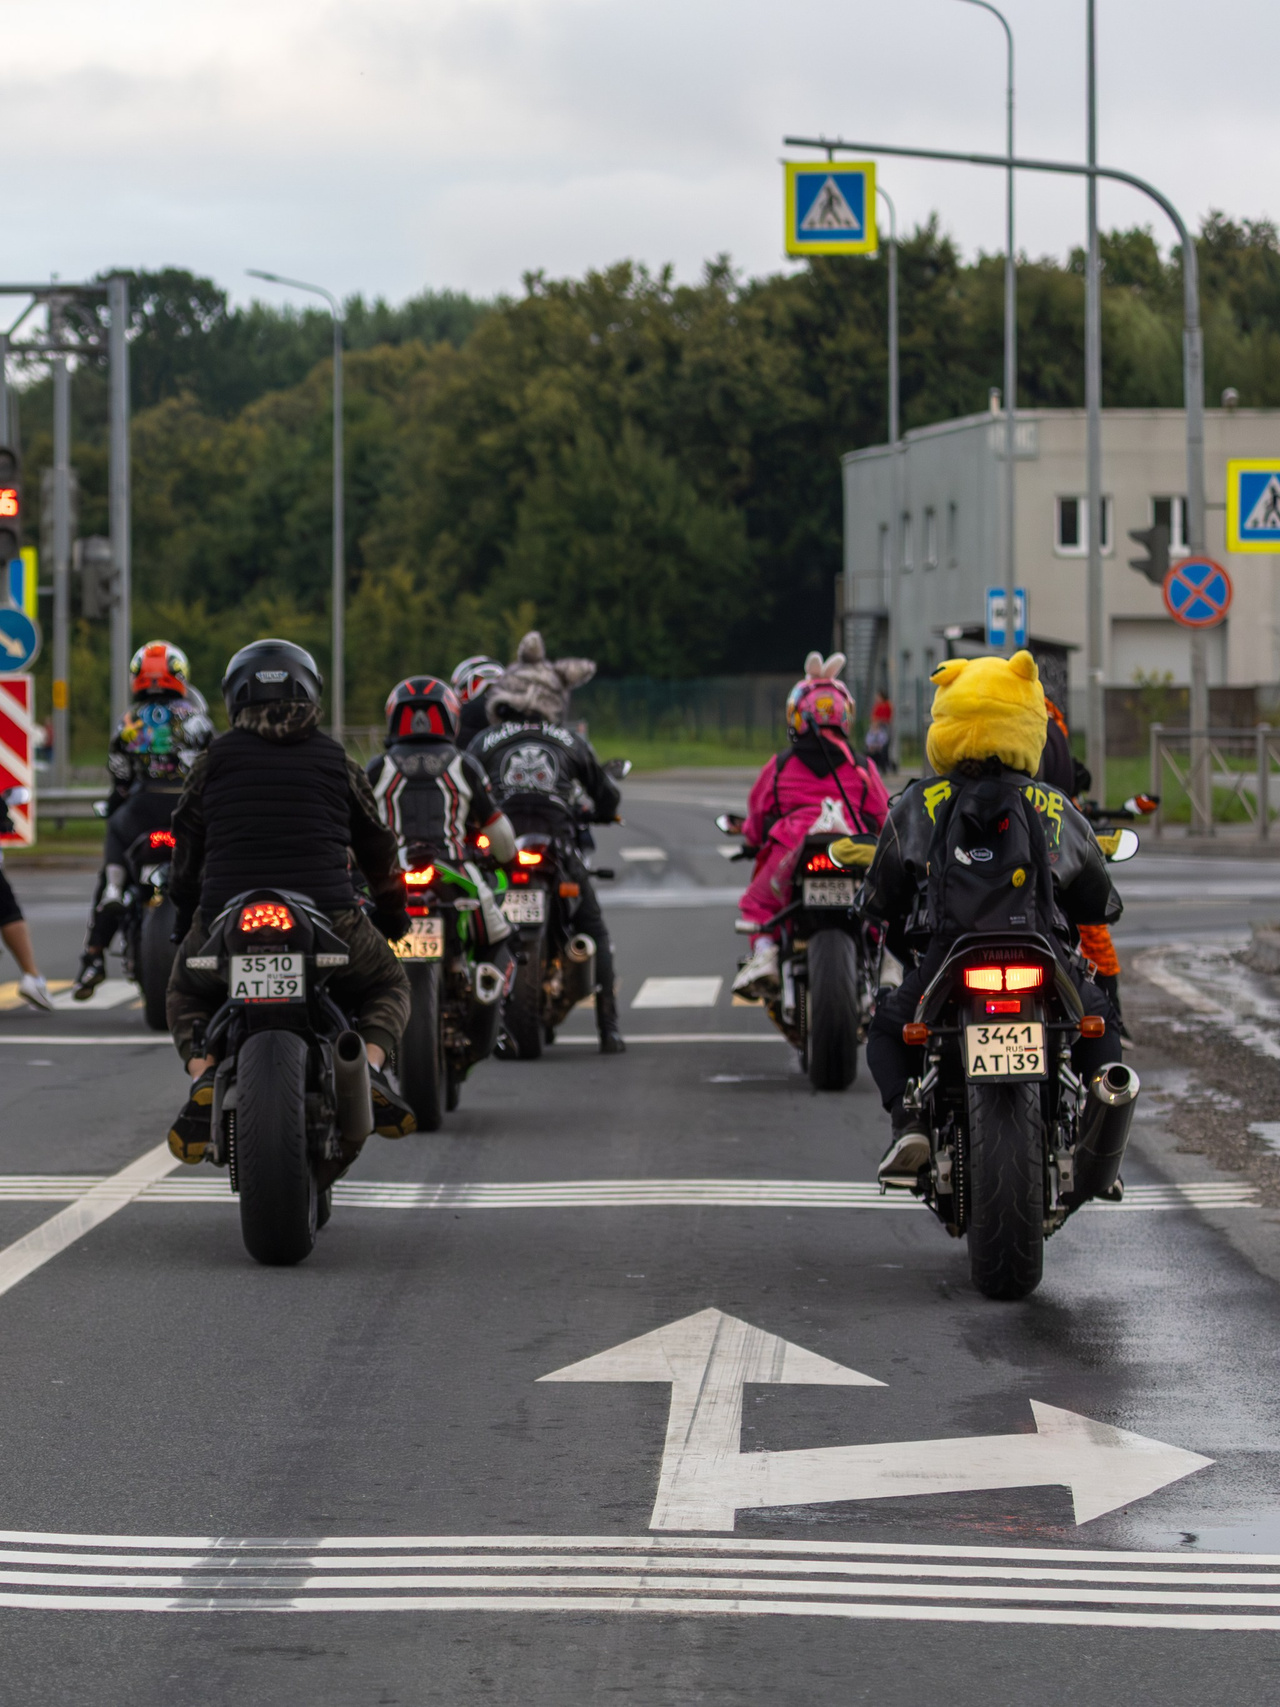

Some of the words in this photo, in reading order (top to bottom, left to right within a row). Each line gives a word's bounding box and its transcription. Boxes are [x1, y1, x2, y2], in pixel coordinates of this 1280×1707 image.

[419, 941, 438, 956] 39
[982, 949, 1025, 960] YAMAHA
[241, 956, 293, 973] 3510
[235, 981, 264, 996] AT
[273, 980, 298, 995] 39
[977, 1026, 1033, 1045] 3441
[1006, 1045, 1023, 1053] RUS
[972, 1055, 1004, 1073] AT
[1012, 1053, 1039, 1071] 39
